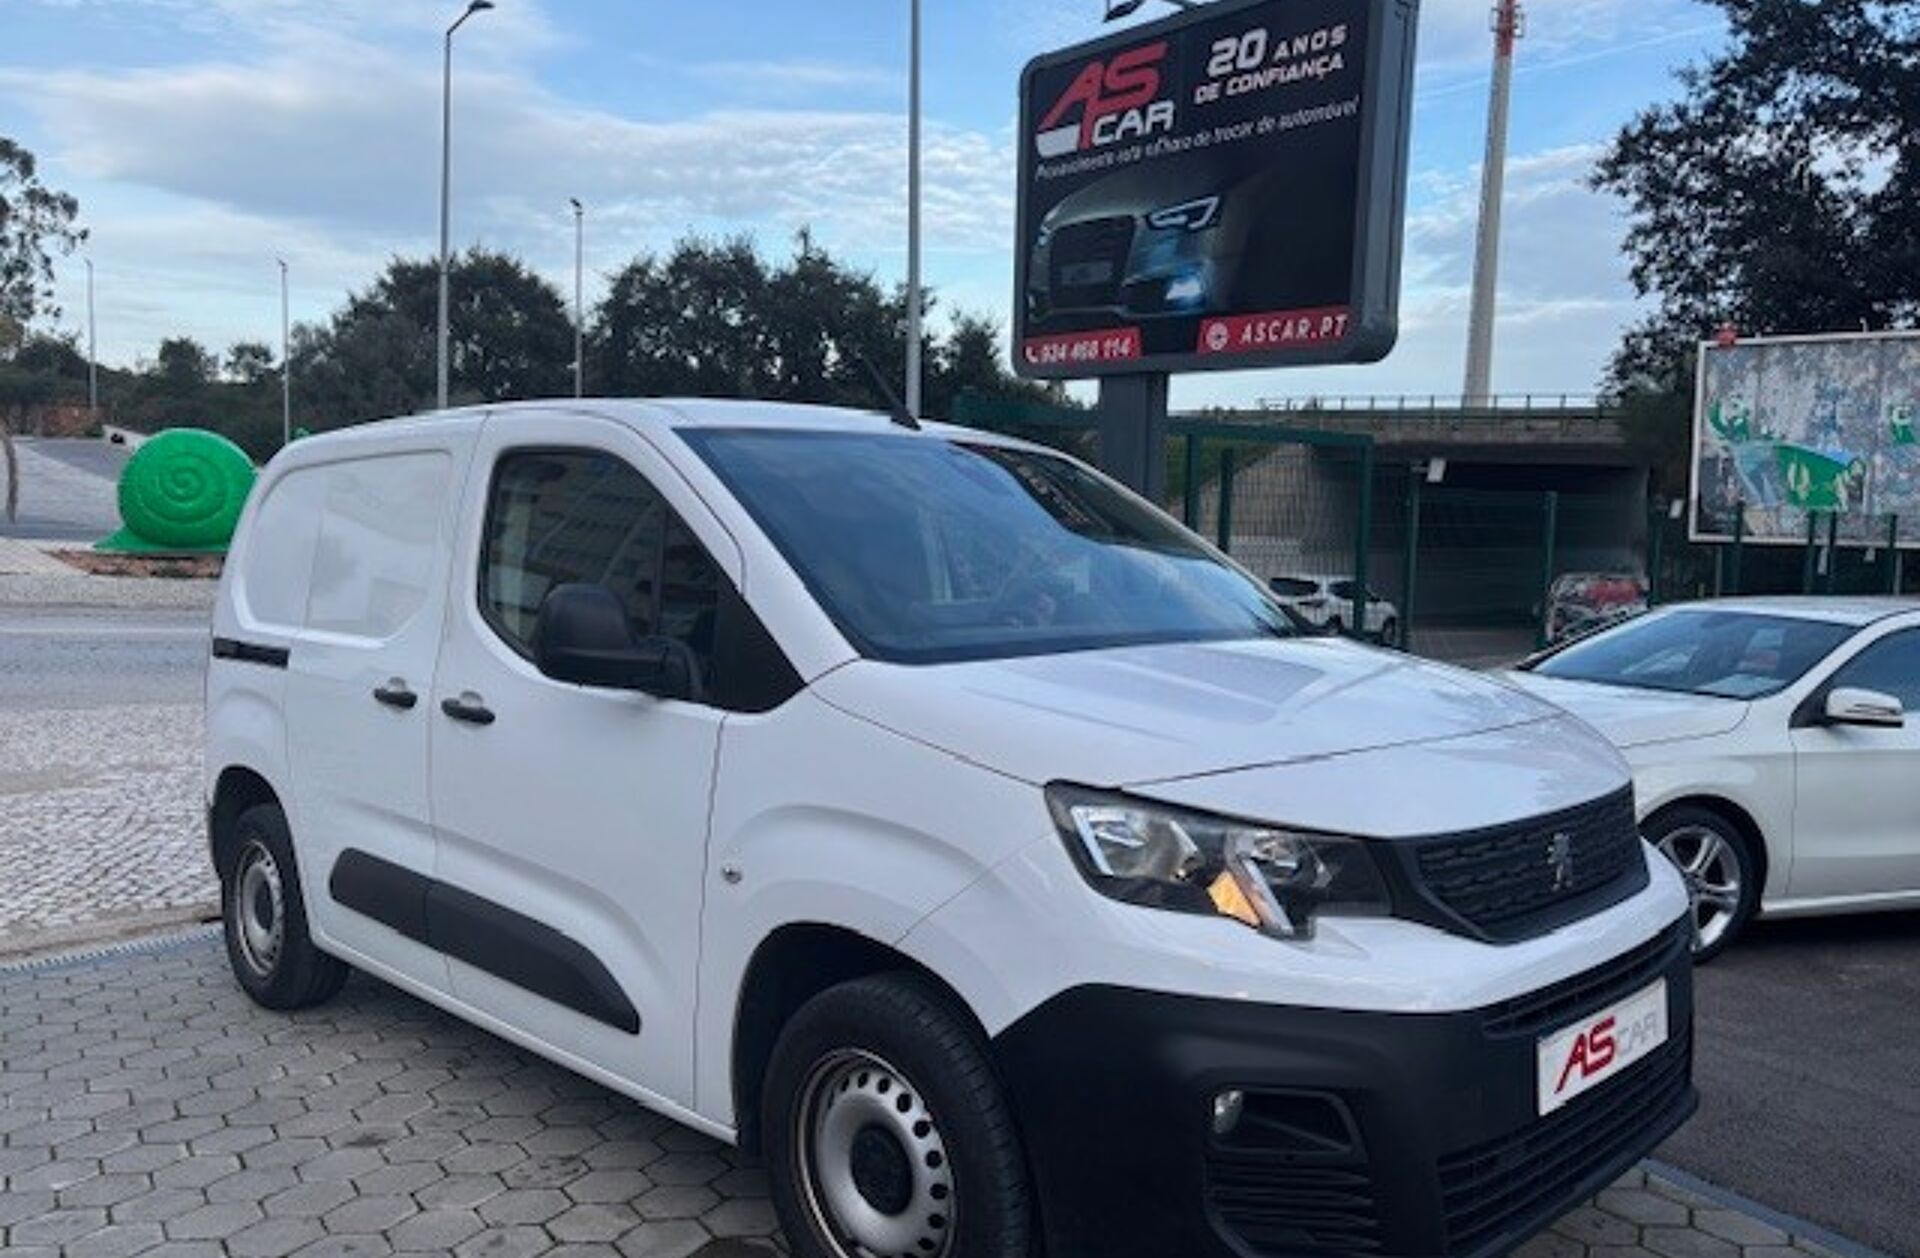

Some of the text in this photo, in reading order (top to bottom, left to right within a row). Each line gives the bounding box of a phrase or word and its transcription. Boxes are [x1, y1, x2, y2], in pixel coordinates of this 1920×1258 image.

[1207, 24, 1347, 77] 20 ANOS
[1036, 41, 1168, 150] AS
[1194, 53, 1344, 104] DE CONFIANÇA
[1092, 100, 1175, 146] CAR
[1239, 313, 1348, 345] ASCAR.PT
